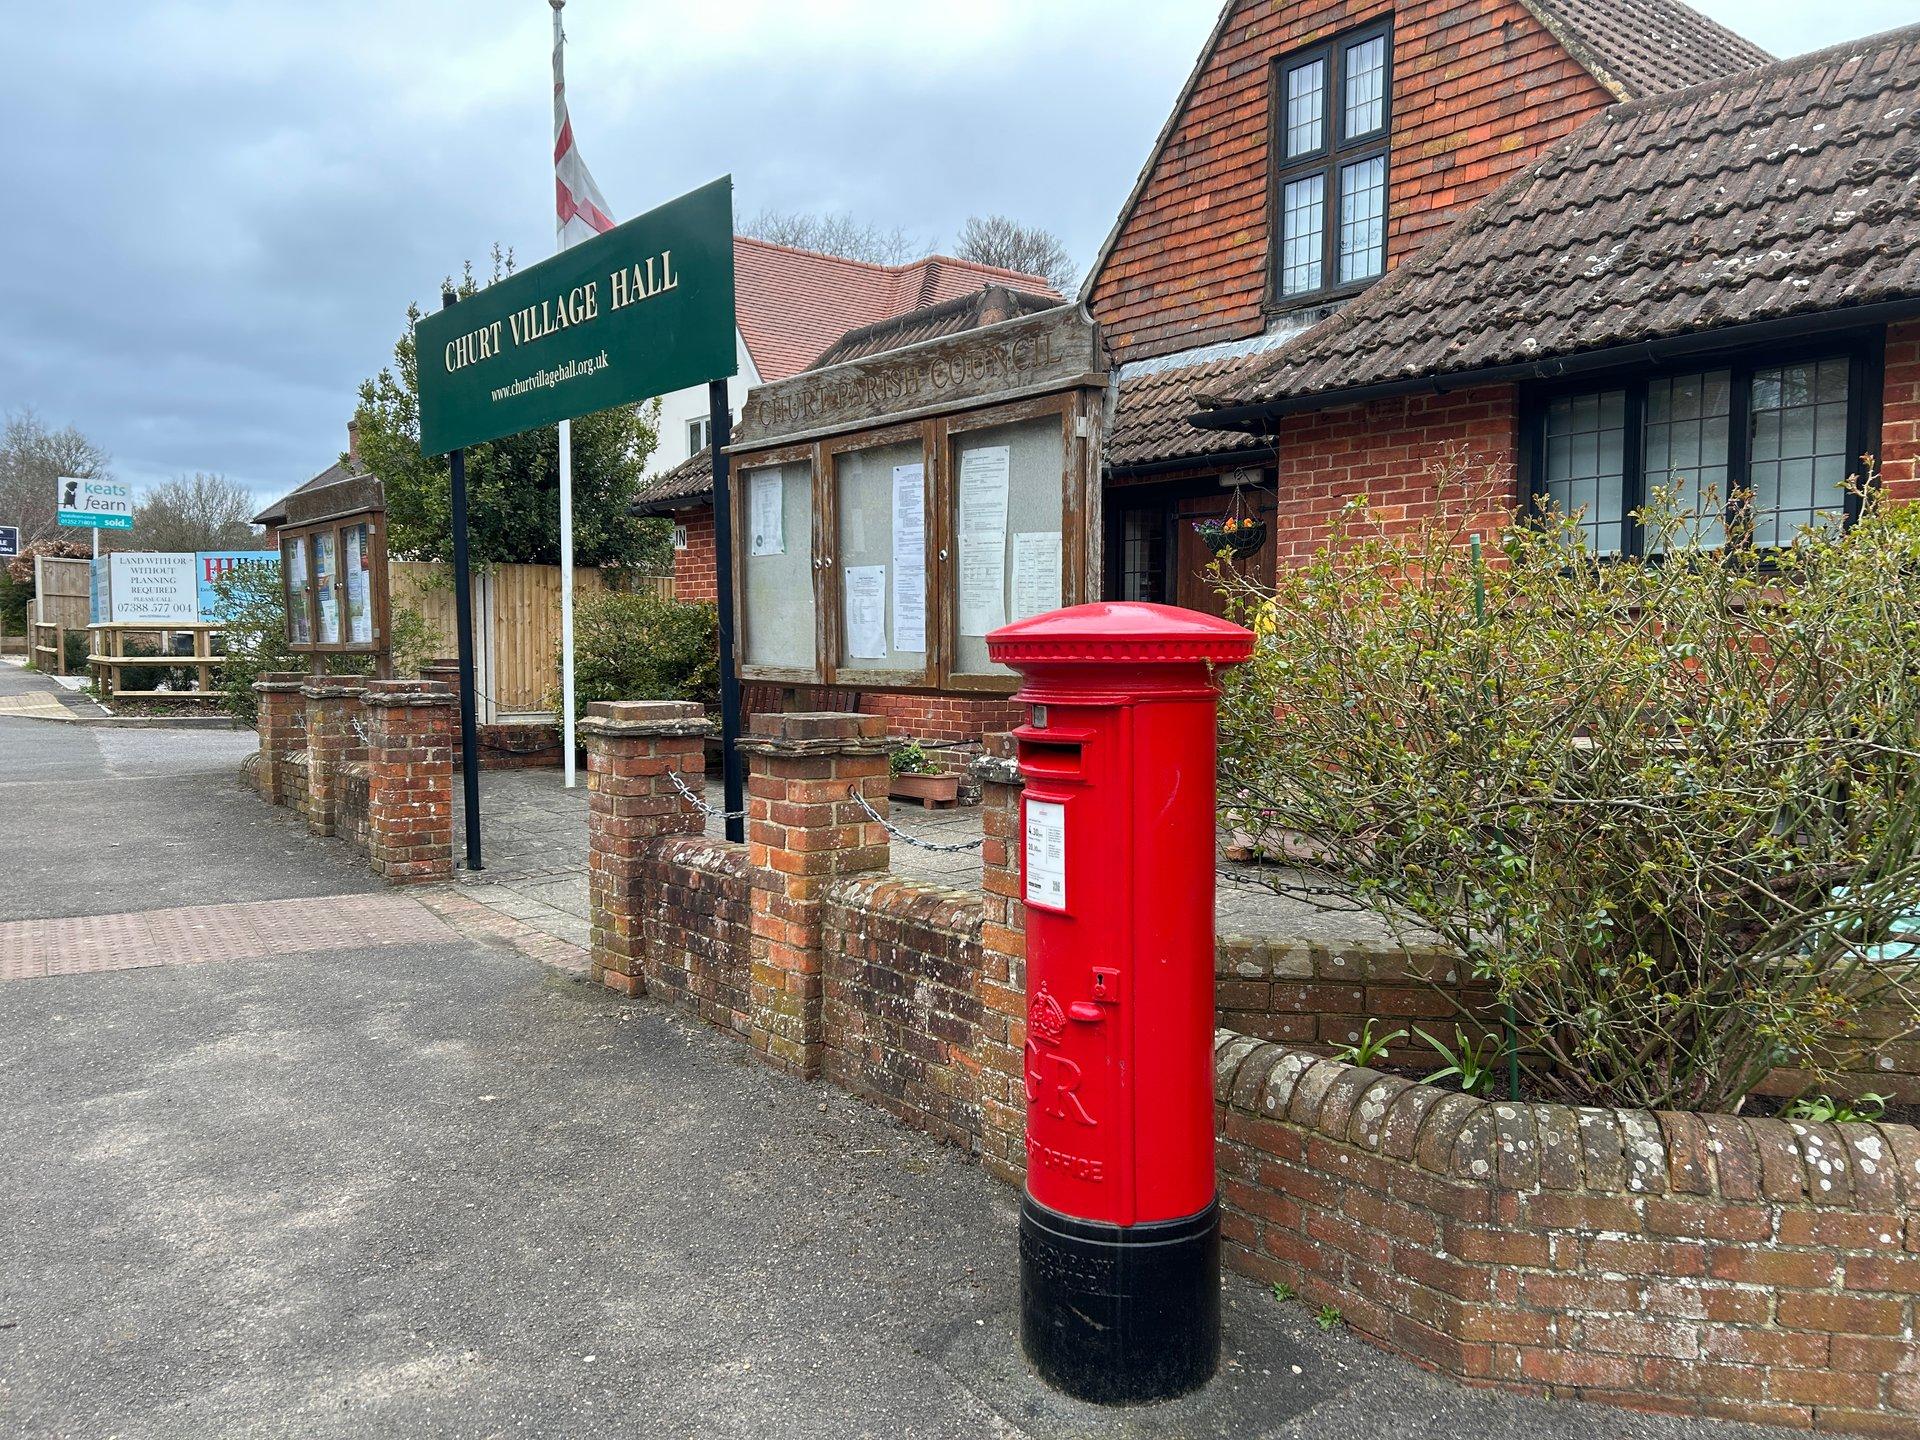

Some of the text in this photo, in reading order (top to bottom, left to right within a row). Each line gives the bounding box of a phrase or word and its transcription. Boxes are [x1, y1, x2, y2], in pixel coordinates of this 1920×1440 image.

[444, 250, 679, 373] CHURT VILLAGE HALL
[491, 350, 609, 402] www.churtvillagehall.org.uk
[758, 386, 828, 427] CHURT
[838, 368, 920, 408] PARISH
[930, 332, 1063, 389] COUNCIL
[84, 482, 126, 496] keats
[84, 495, 126, 511] fearn
[104, 518, 125, 527] sold
[120, 557, 144, 565] LAND
[145, 557, 170, 565] WITH
[131, 567, 176, 575] WITHOUT
[131, 586, 177, 594] REQUIRED
[117, 603, 192, 613] 07388 577 004
[1044, 1147, 1104, 1182] OFFICE
